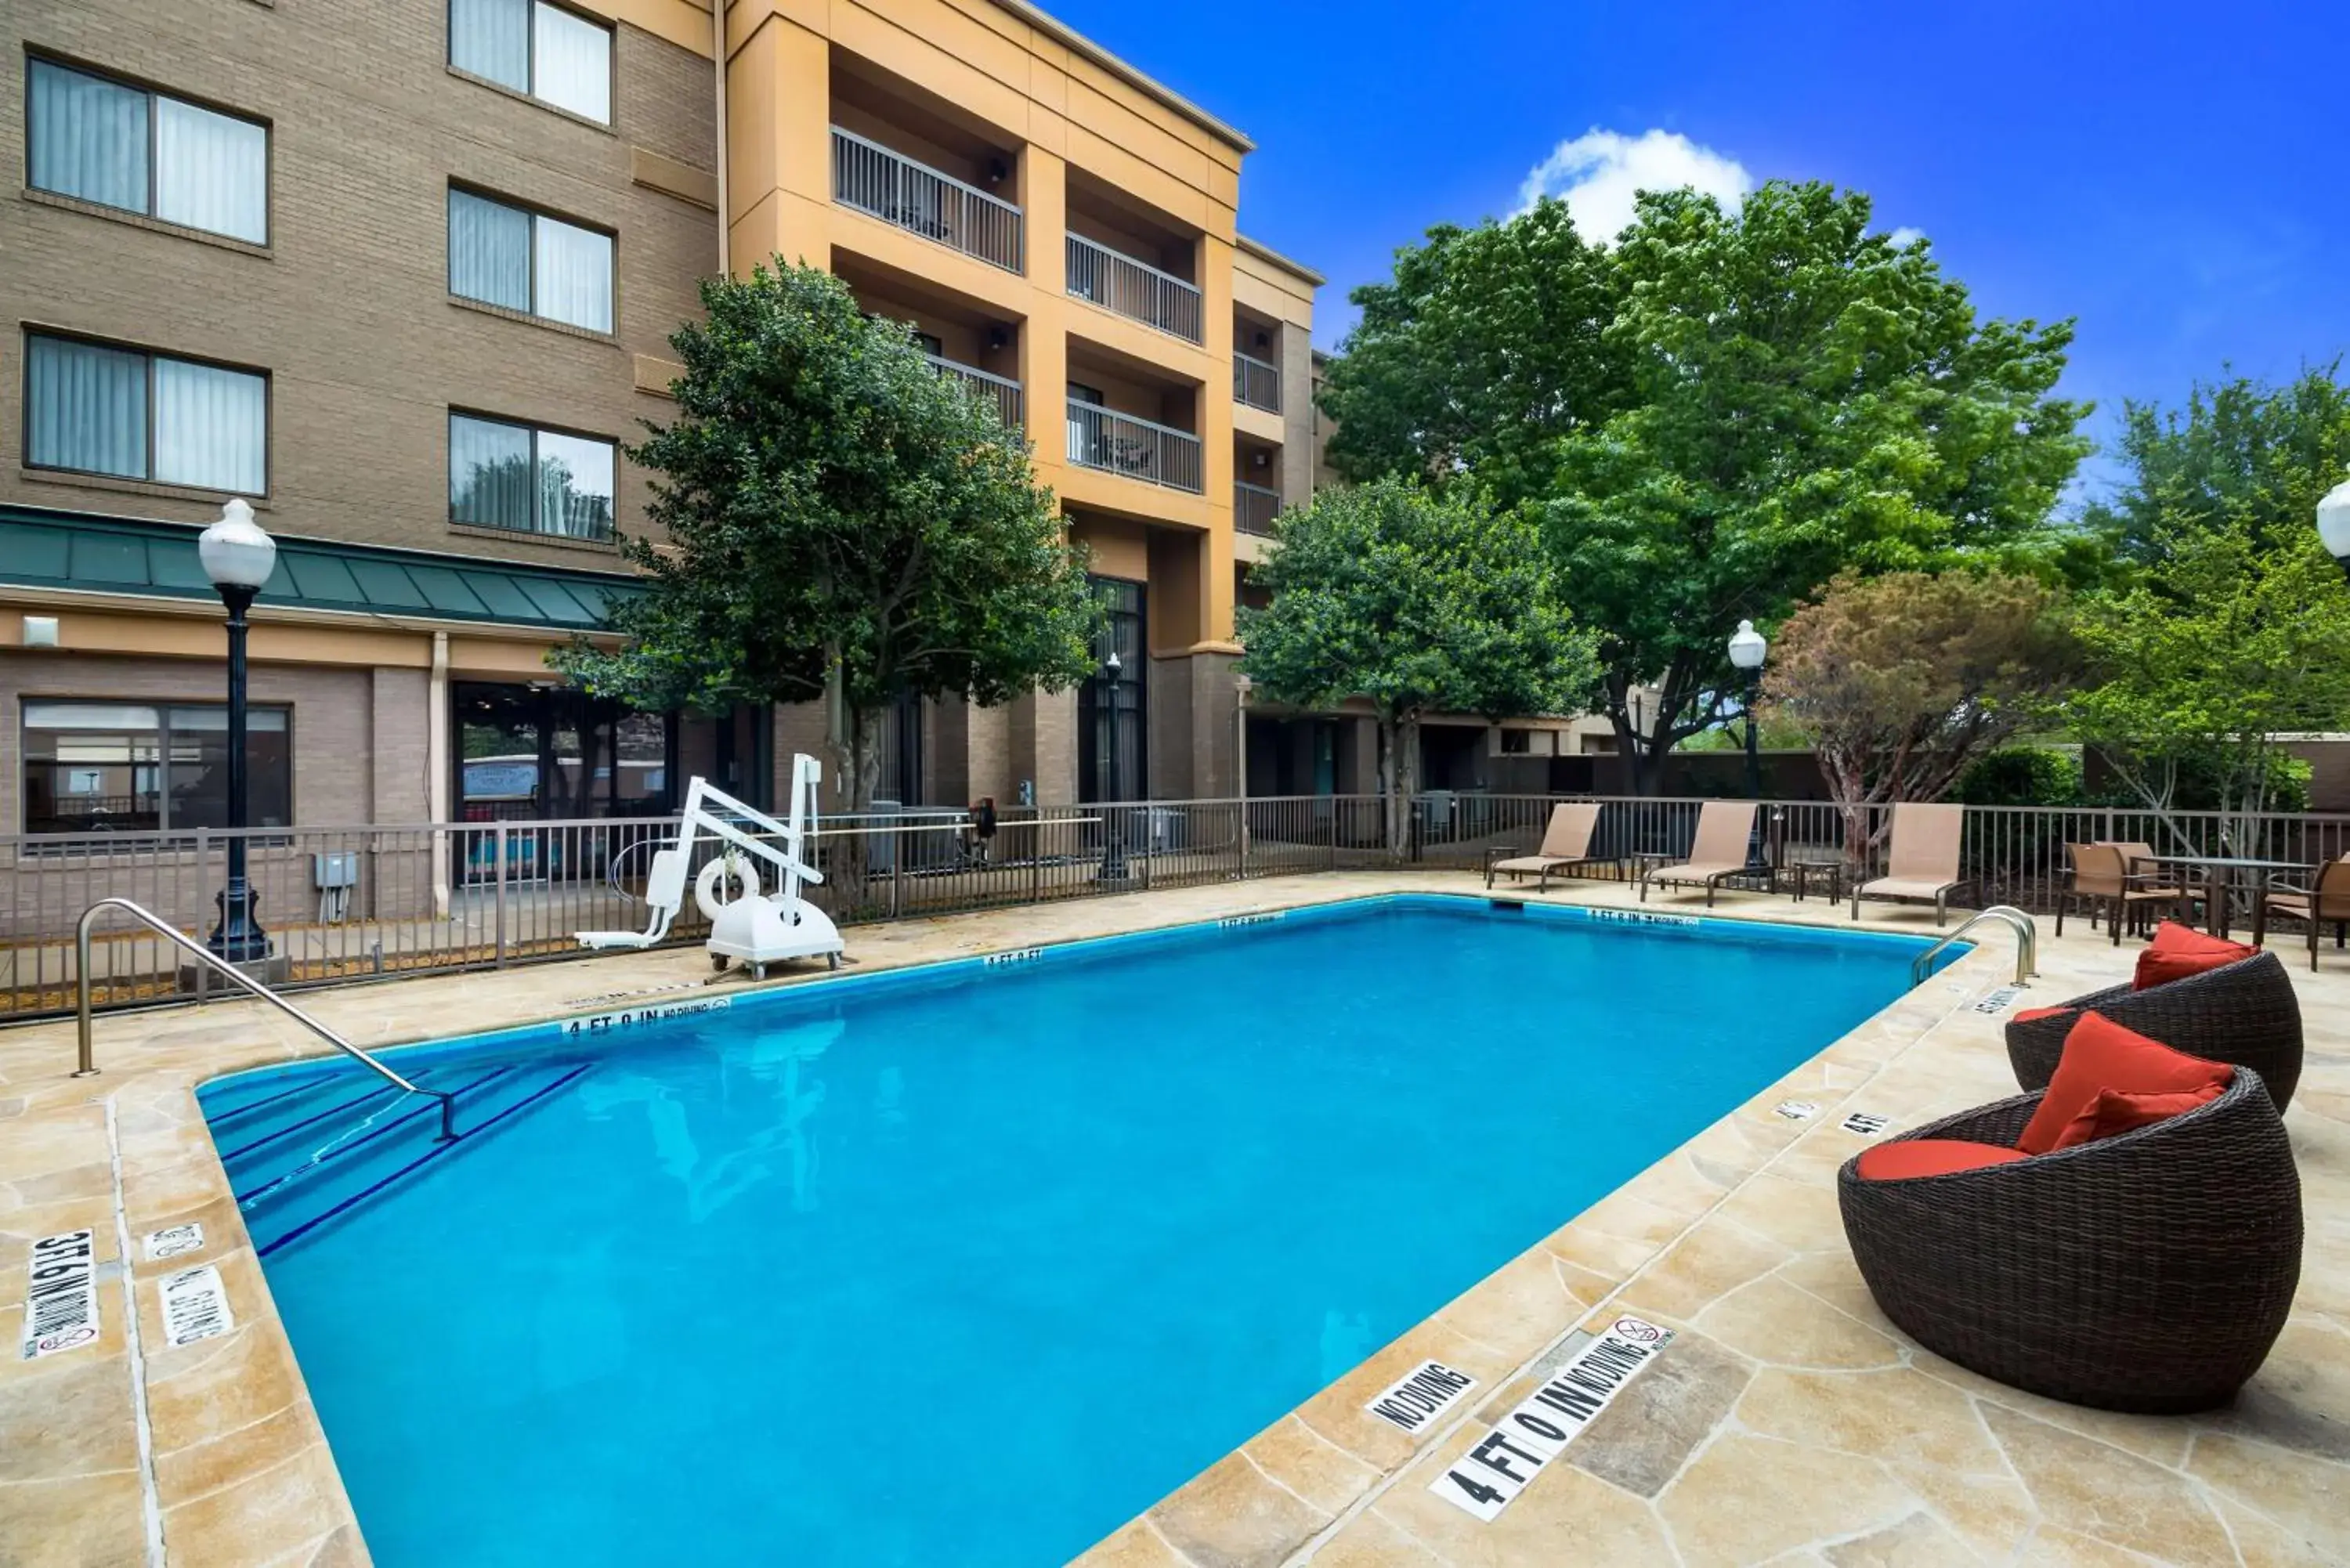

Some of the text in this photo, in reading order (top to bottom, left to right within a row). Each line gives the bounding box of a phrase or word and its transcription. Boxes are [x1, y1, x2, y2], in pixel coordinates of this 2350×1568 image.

[569, 1021, 580, 1034] 4
[590, 1016, 611, 1030] FT
[640, 1010, 657, 1023] IN
[1843, 1122, 1878, 1133] 4
[34, 1232, 89, 1249] 3
[34, 1243, 89, 1266] FT
[32, 1263, 89, 1281] 6
[31, 1273, 89, 1300] IN
[1578, 1336, 1650, 1382] DIVING
[1563, 1367, 1615, 1396] NO
[1372, 1364, 1472, 1430] NO DIVING
[1535, 1381, 1604, 1422] IN
[1470, 1431, 1544, 1483] FT
[1448, 1469, 1506, 1505] 4
